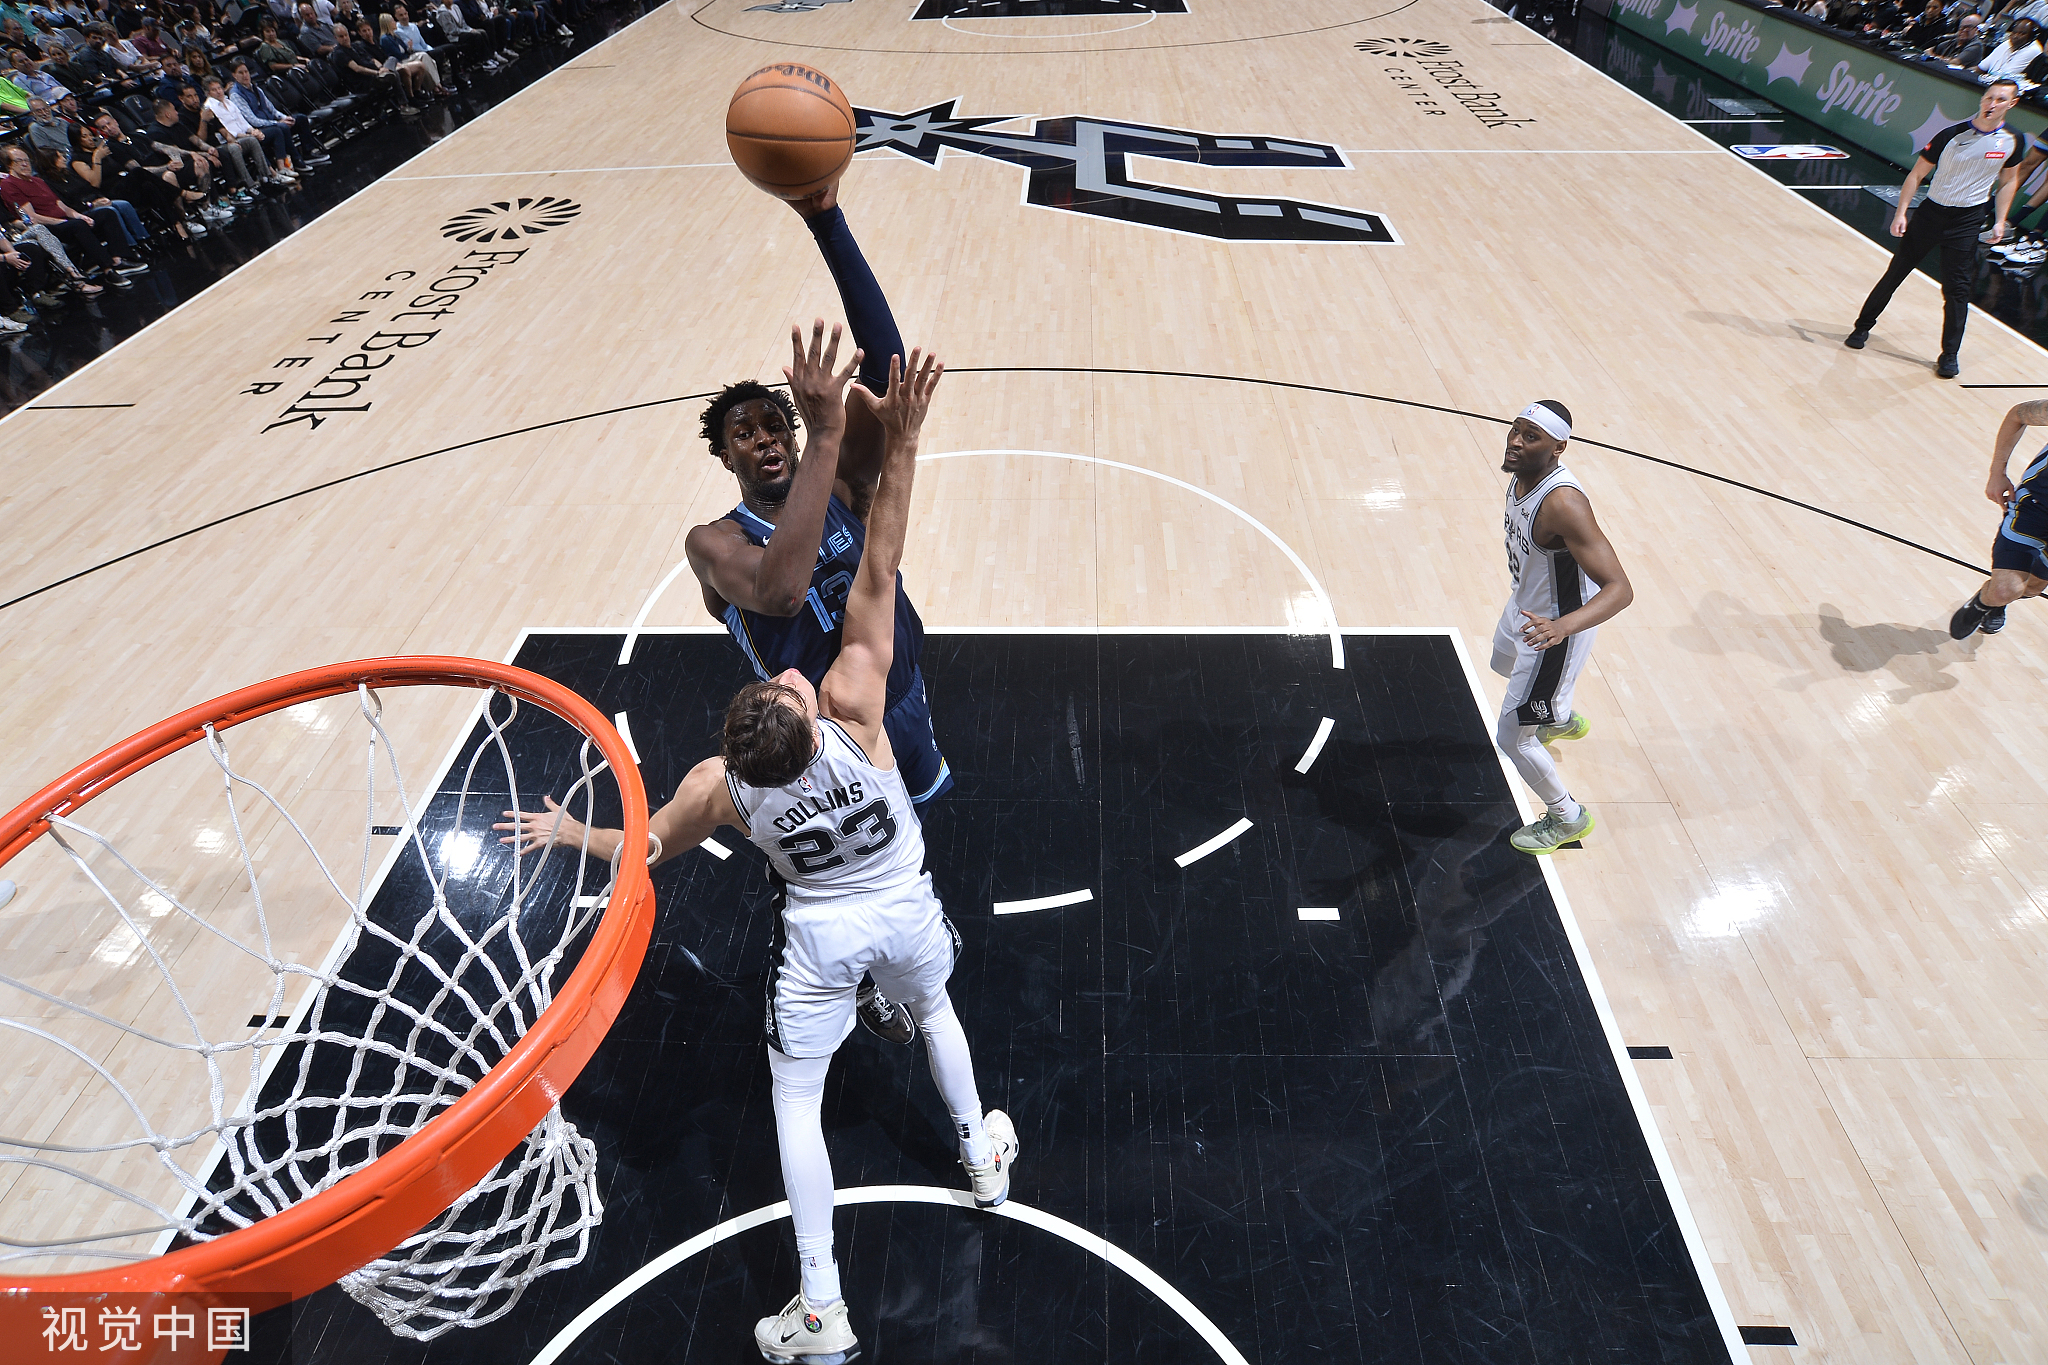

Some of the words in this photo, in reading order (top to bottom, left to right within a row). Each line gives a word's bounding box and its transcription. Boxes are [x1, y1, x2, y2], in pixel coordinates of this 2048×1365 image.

[1617, 0, 1661, 19] prite
[1701, 11, 1761, 64] Sprite
[1384, 67, 1447, 115] CENTER
[1416, 60, 1484, 89] Frost
[1451, 92, 1538, 129] Bank
[1816, 60, 1901, 126] Sprite
[390, 248, 530, 322] Frost
[239, 270, 417, 395] CENTER
[260, 328, 442, 434] Bank
[805, 570, 854, 633] 13
[772, 781, 864, 833] COLLINS
[775, 796, 898, 874] 23
